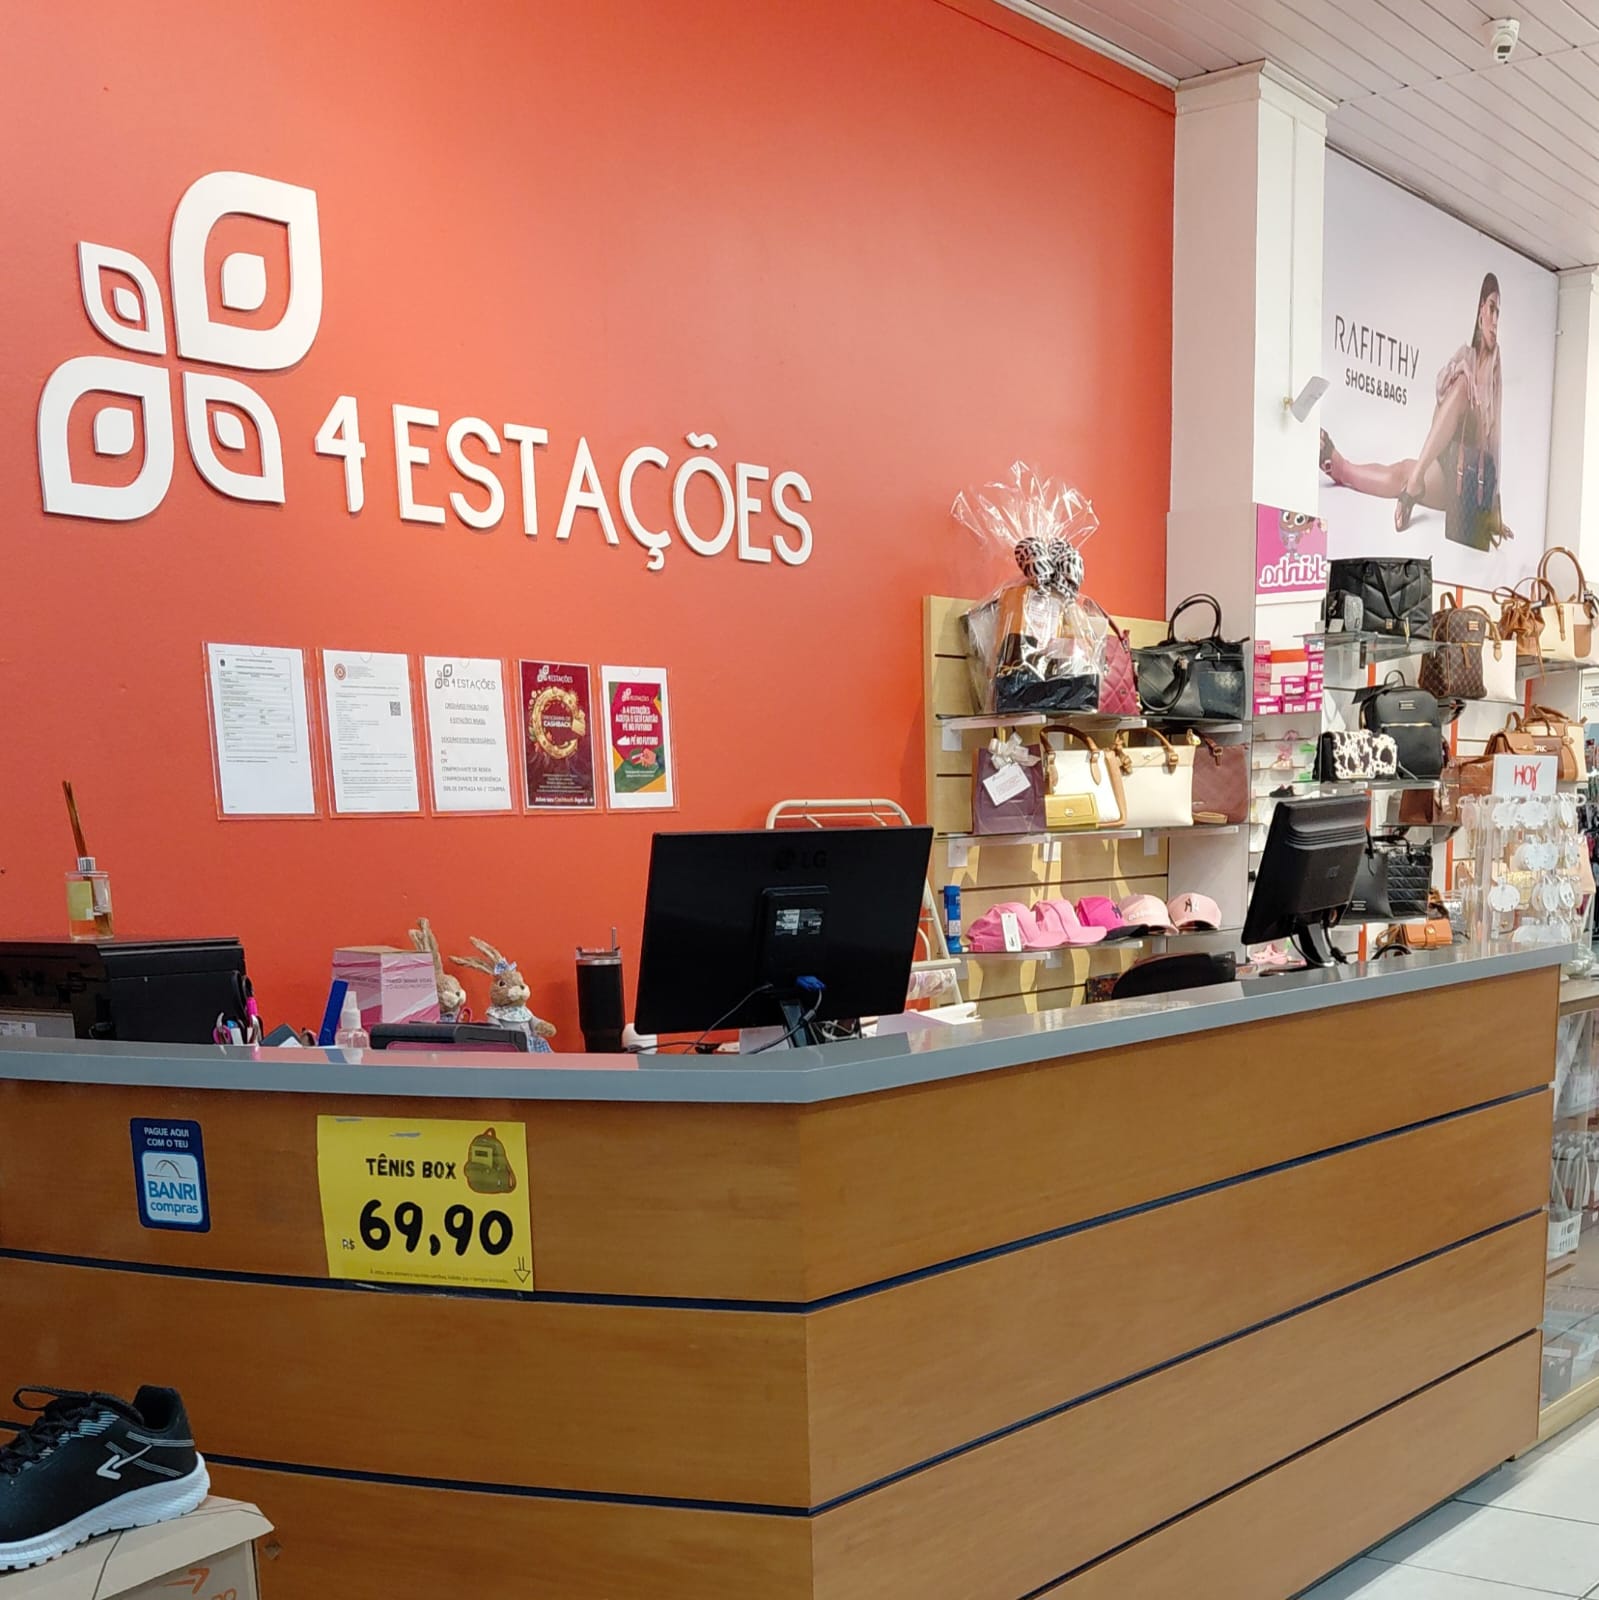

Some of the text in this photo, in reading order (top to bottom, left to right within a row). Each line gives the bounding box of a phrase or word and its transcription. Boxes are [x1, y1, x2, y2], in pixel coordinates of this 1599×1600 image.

[1334, 314, 1419, 380] RAFITTHY
[314, 395, 813, 570] 4 ESTAÇÕES
[457, 678, 496, 690] ESTAÇÕES
[543, 720, 571, 728] CASHBACK
[144, 1127, 189, 1137] PAGUE AQUI
[146, 1138, 189, 1148] COM O TEU
[366, 1153, 456, 1180] TÊNIS BOX
[148, 1181, 197, 1201] BANRI
[150, 1201, 199, 1216] compras
[359, 1199, 513, 1256] 69,90
